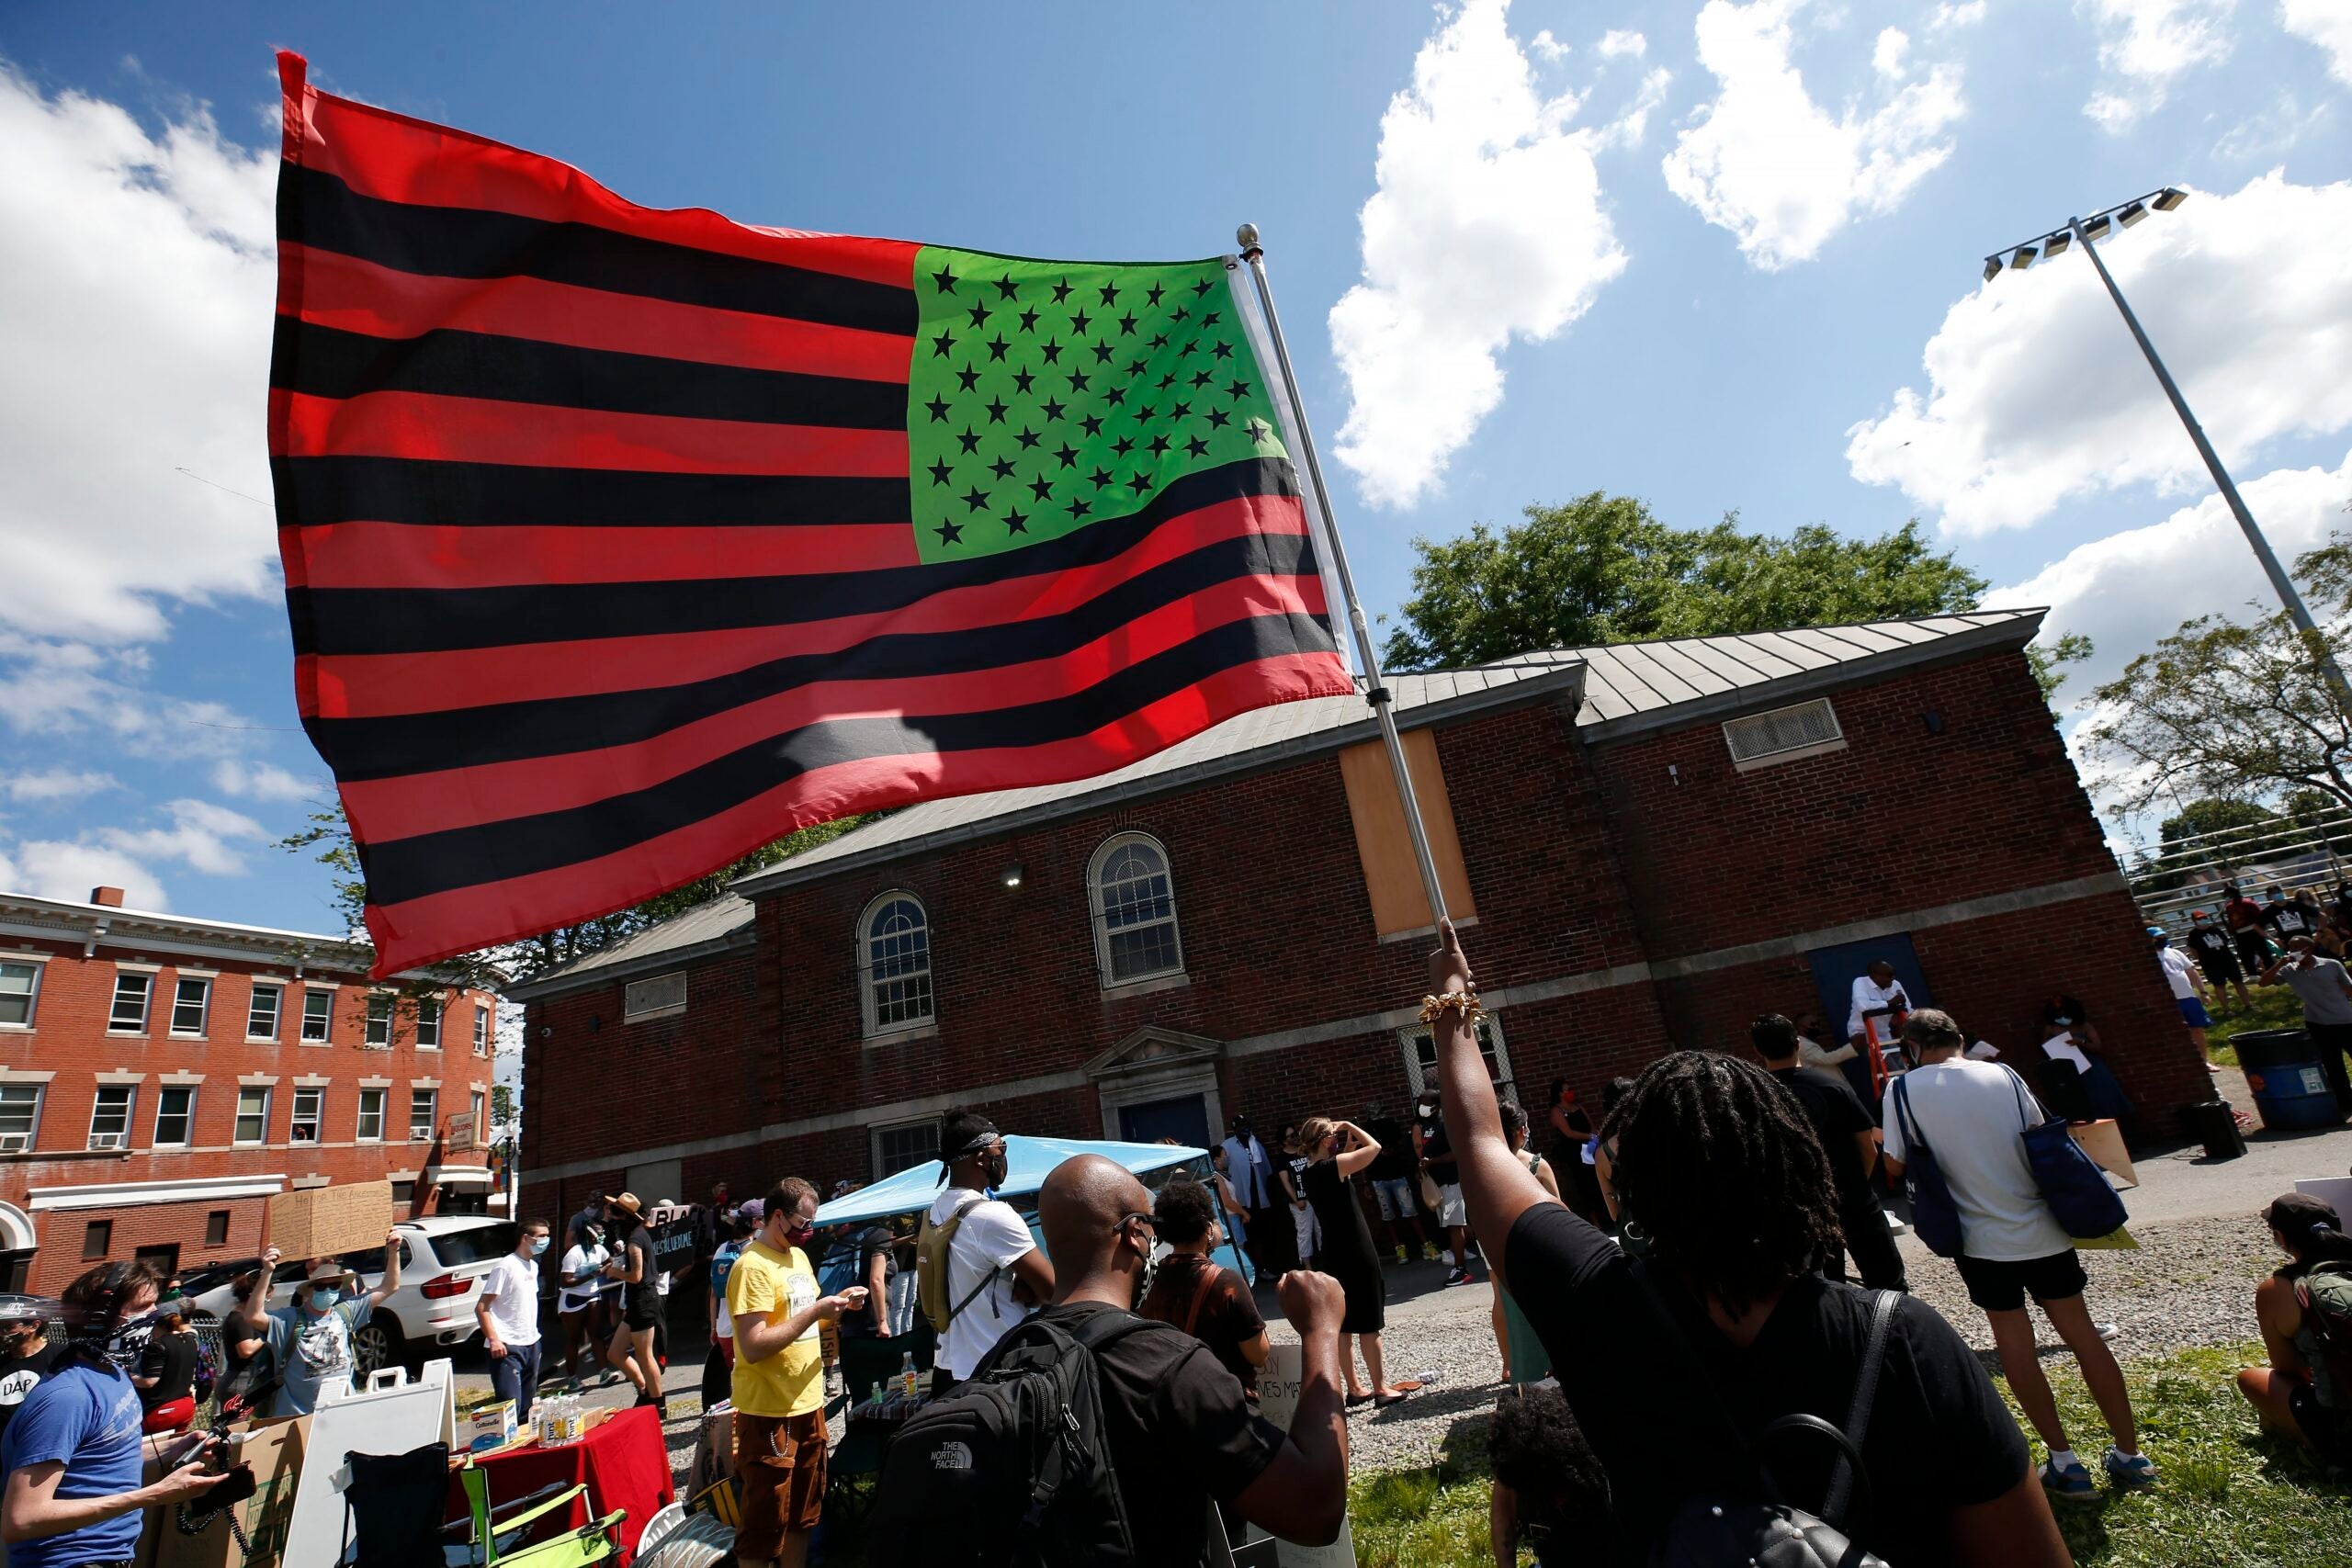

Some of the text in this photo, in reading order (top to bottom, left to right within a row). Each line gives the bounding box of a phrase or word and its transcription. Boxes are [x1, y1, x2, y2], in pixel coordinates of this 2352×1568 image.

[295, 1192, 328, 1208] HONOR
[330, 1190, 348, 1201] THE
[3, 1379, 32, 1396] DAP
[475, 1419, 501, 1428] Cottonelle
[942, 1441, 958, 1451] THE
[930, 1450, 956, 1461] NORTH
[934, 1460, 956, 1470] FACE
